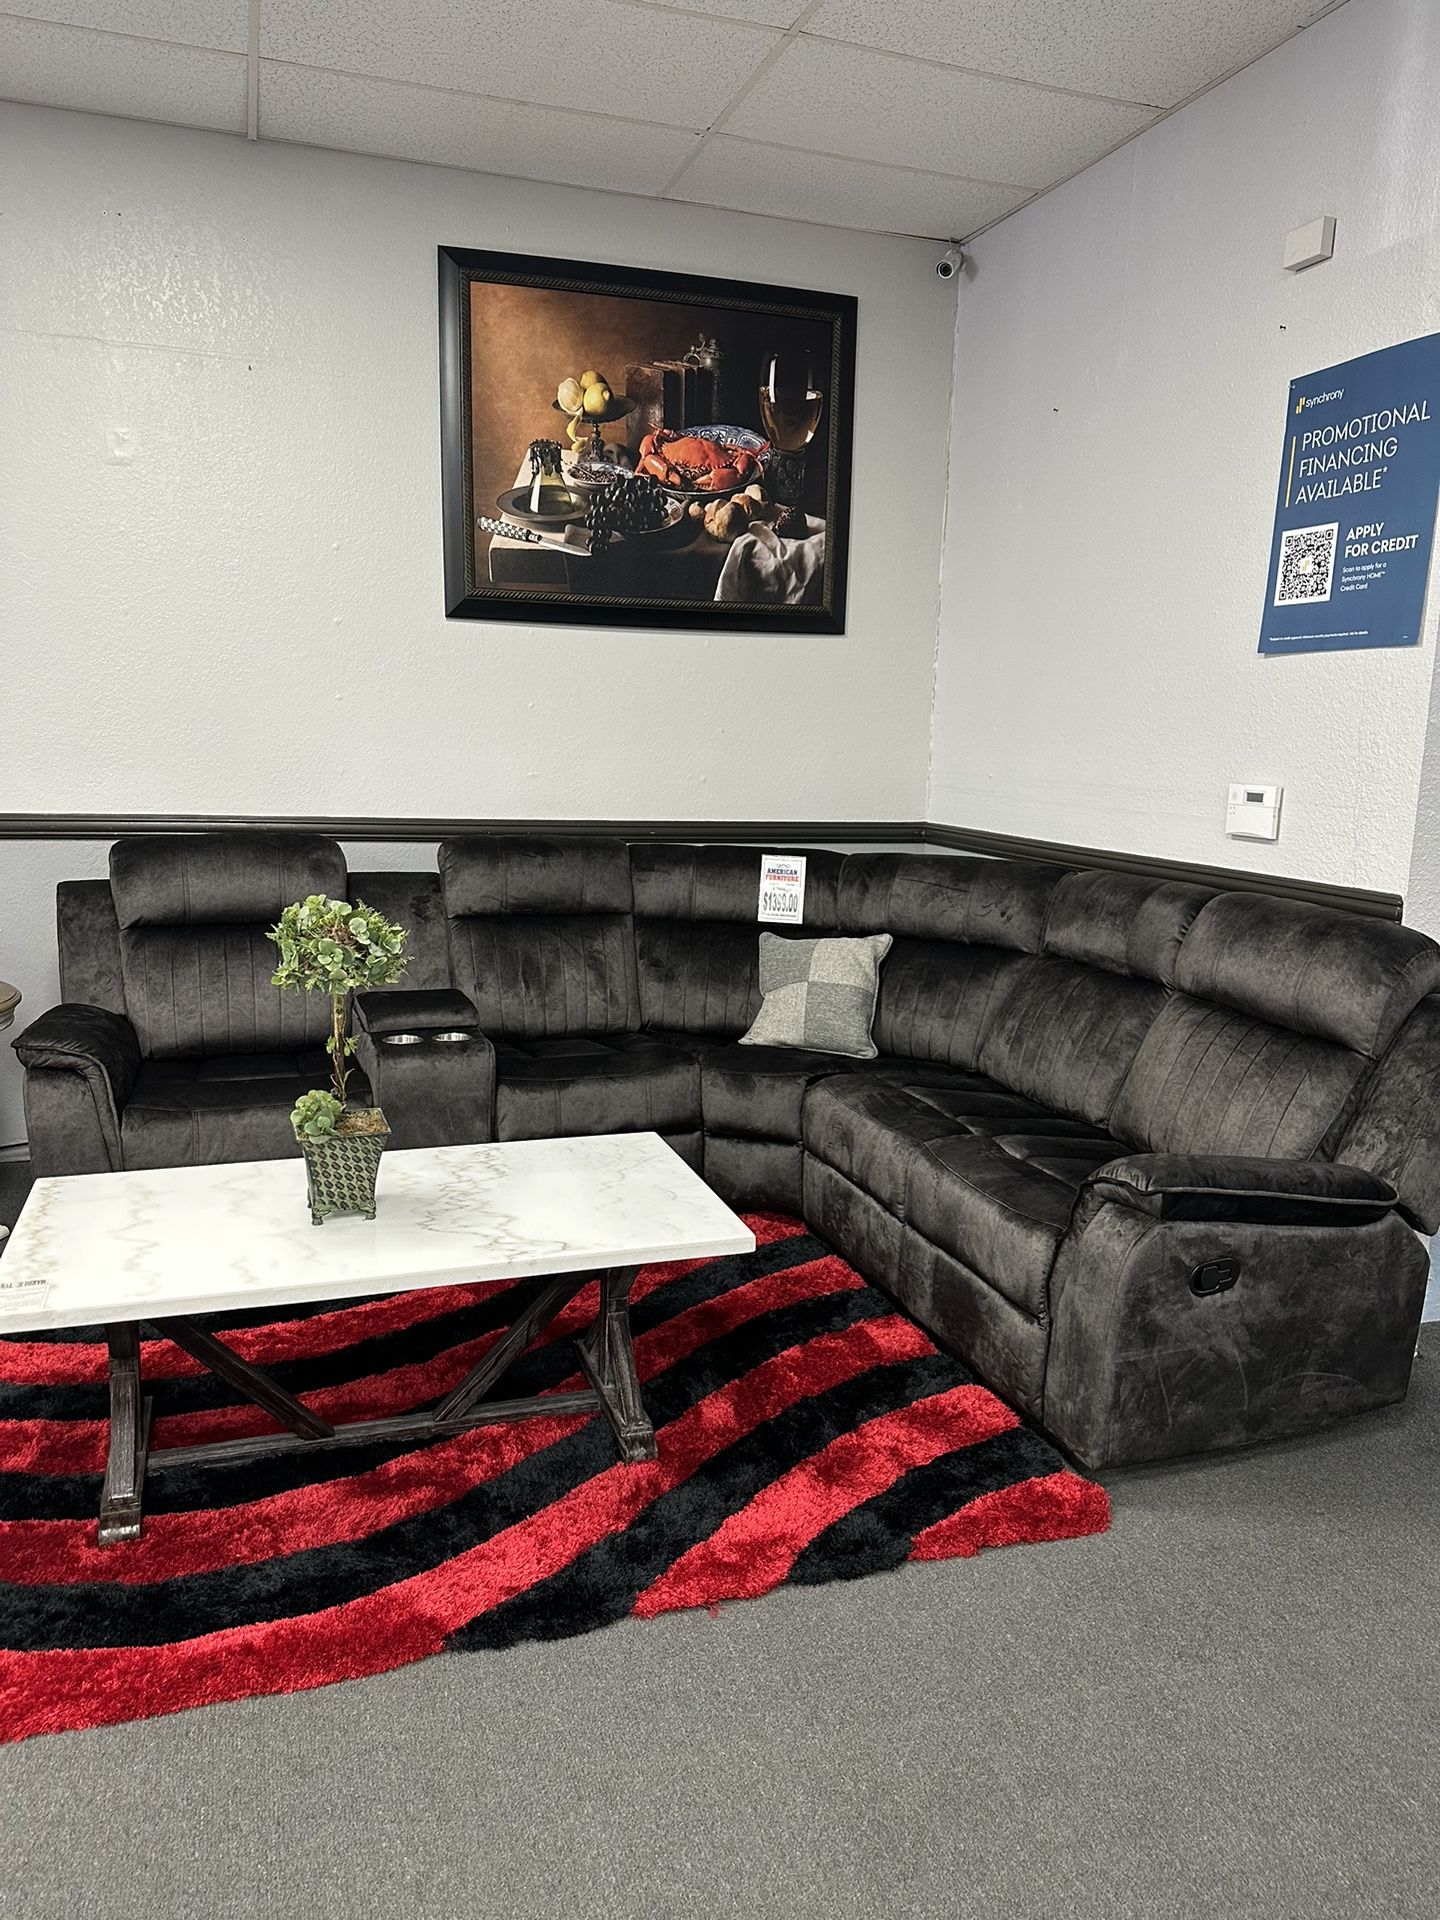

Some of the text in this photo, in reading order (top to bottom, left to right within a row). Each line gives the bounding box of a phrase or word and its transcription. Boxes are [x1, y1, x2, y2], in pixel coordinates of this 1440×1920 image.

[1305, 388, 1345, 409] synchrony
[1302, 400, 1431, 451] PROMOTIONAL
[1299, 437, 1398, 478] FINANCING
[1345, 522, 1385, 542] APPLY
[1344, 535, 1419, 559] FOR CREDIT
[1361, 563, 1375, 573] apply
[1340, 584, 1356, 592] Credit
[1341, 575, 1367, 583] Synchrony
[765, 874, 799, 882] FURNITURE
